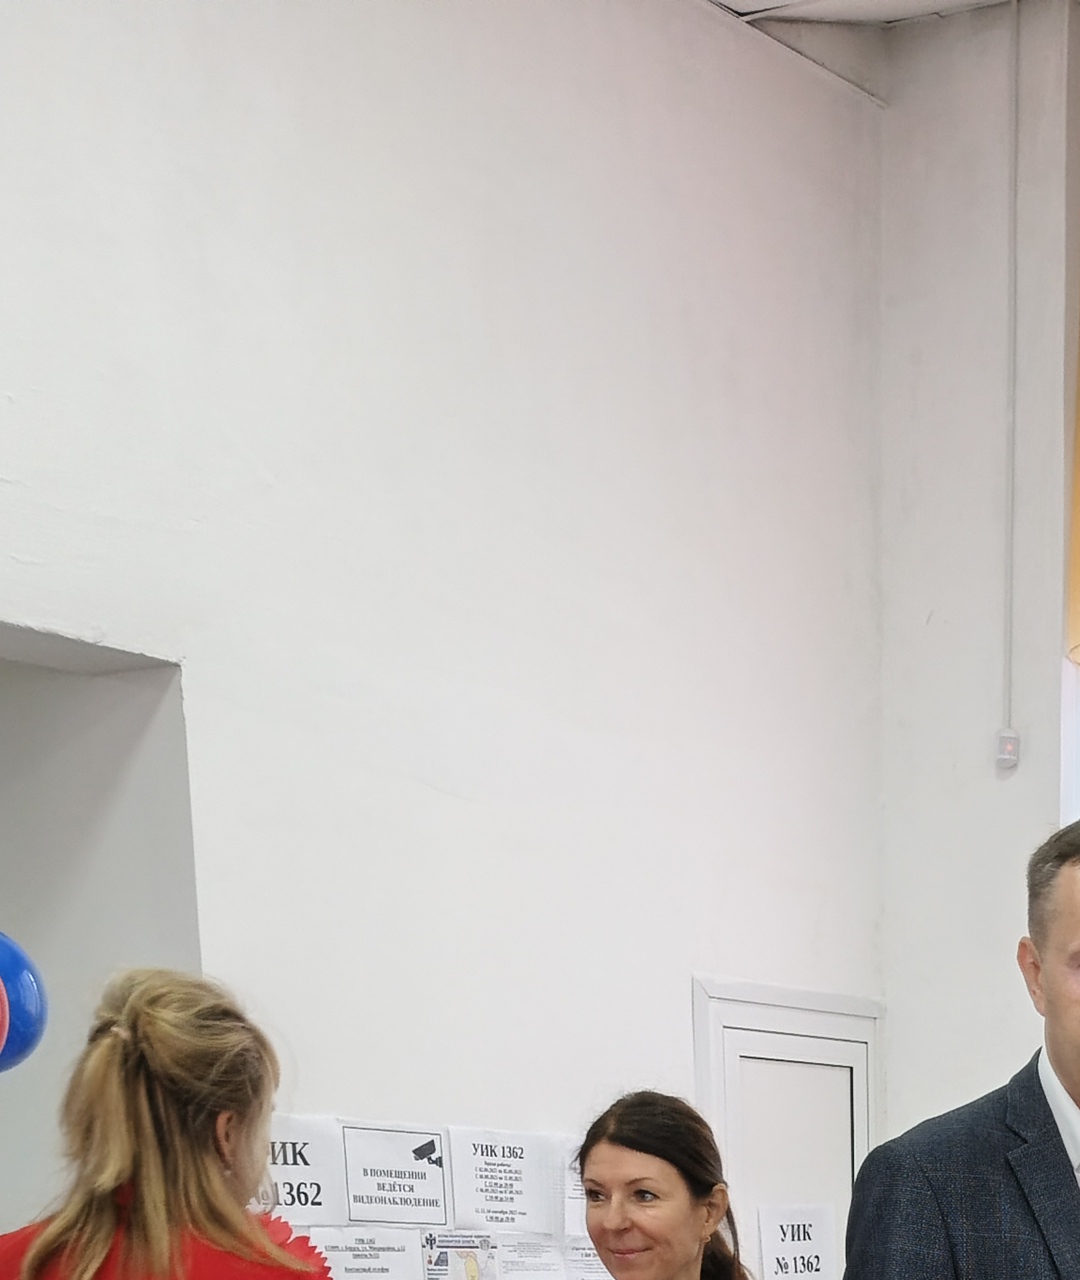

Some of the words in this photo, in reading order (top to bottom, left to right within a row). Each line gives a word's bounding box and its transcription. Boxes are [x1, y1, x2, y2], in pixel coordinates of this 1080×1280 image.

[268, 1141, 311, 1166] ИК
[472, 1143, 498, 1158] УИК
[501, 1146, 525, 1160] 1362
[362, 1168, 369, 1177] В
[370, 1168, 427, 1180] ПОМЕЩЕНИИ
[275, 1181, 323, 1207] 1362
[376, 1181, 415, 1193] ВЕДЁТСЯ
[352, 1194, 441, 1208] ВИДЕОНАБЛЮДЕНИЕ
[779, 1223, 813, 1242] УИК
[774, 1256, 789, 1275] №
[793, 1254, 821, 1274] 1362
